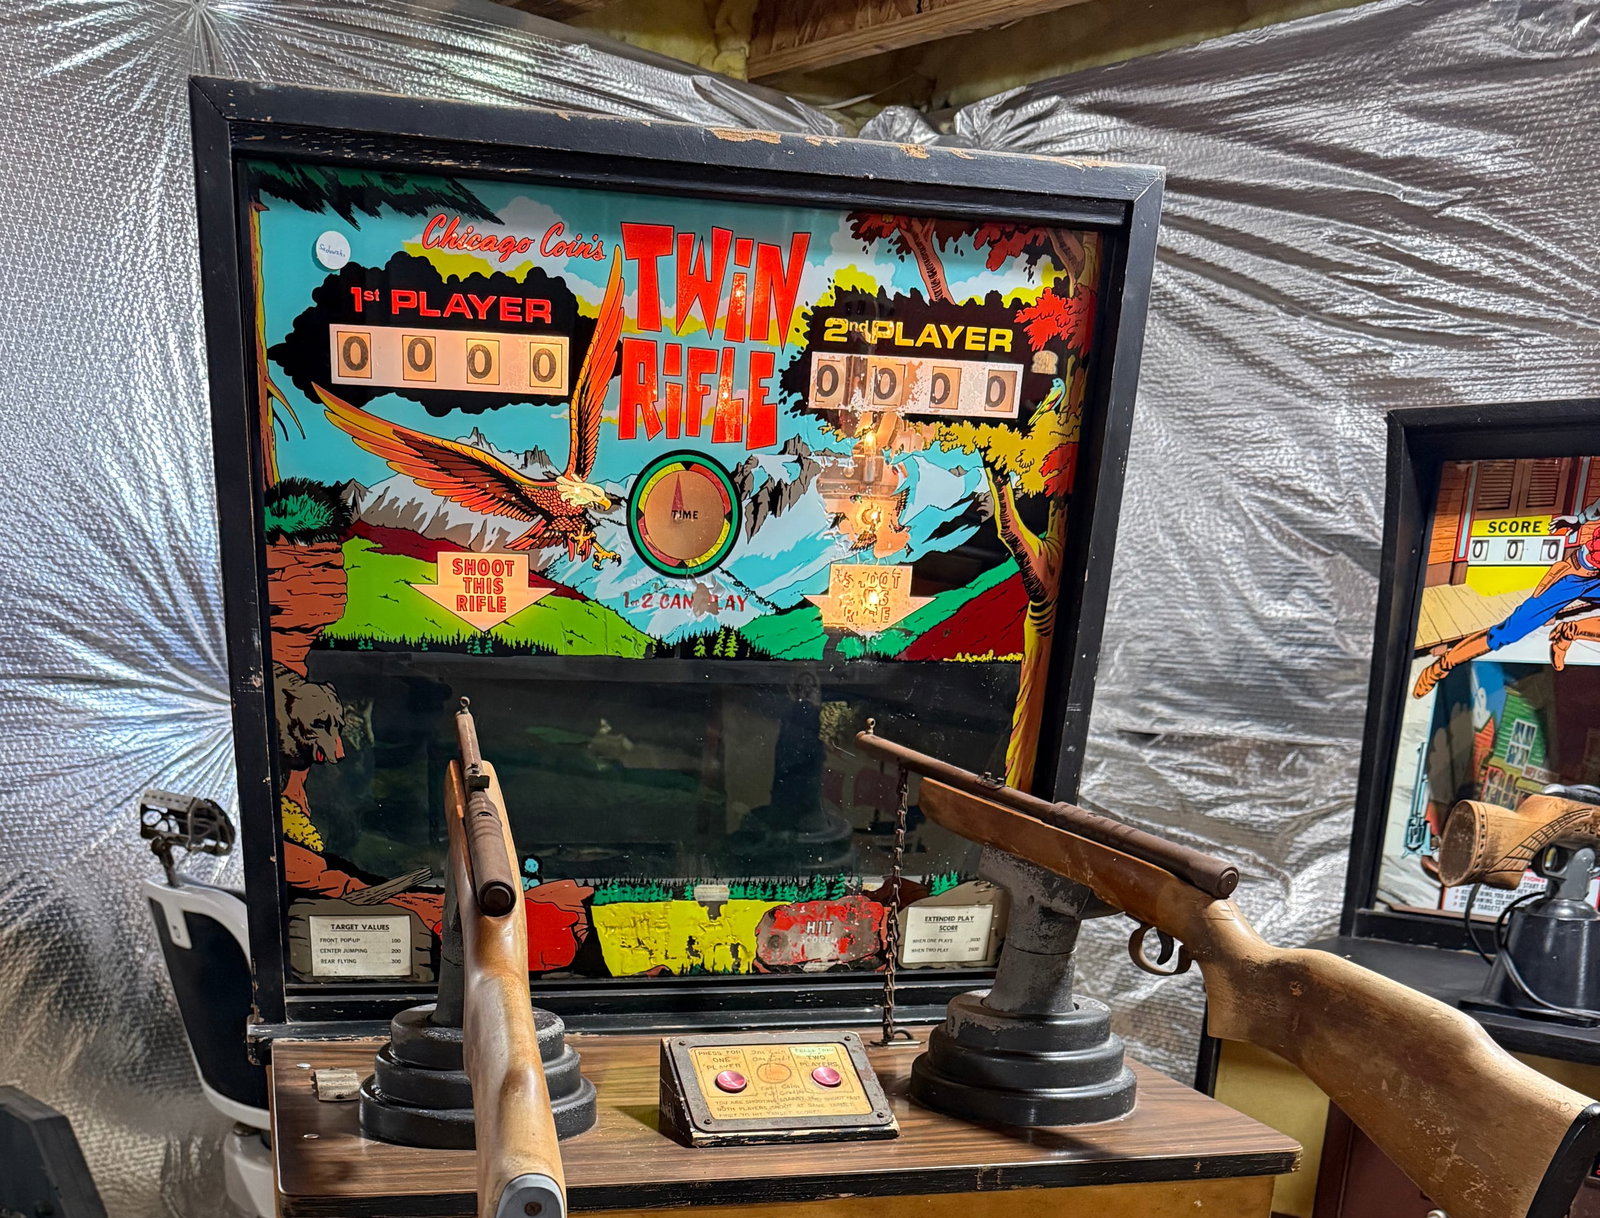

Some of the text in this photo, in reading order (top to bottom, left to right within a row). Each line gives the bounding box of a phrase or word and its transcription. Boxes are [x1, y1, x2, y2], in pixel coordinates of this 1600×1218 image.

[422, 213, 607, 262] Chicago Coin's
[351, 287, 552, 323] 1st PLAYER
[824, 317, 1014, 352] 2nd PLAYER
[672, 510, 698, 519] TIME
[1488, 521, 1543, 534] SCORE
[452, 558, 515, 577] SHOOT
[462, 577, 504, 595] THIS
[456, 595, 507, 613] RIFLE
[641, 593, 653, 608] 2
[660, 593, 694, 609] CAN
[807, 921, 833, 934] HIT
